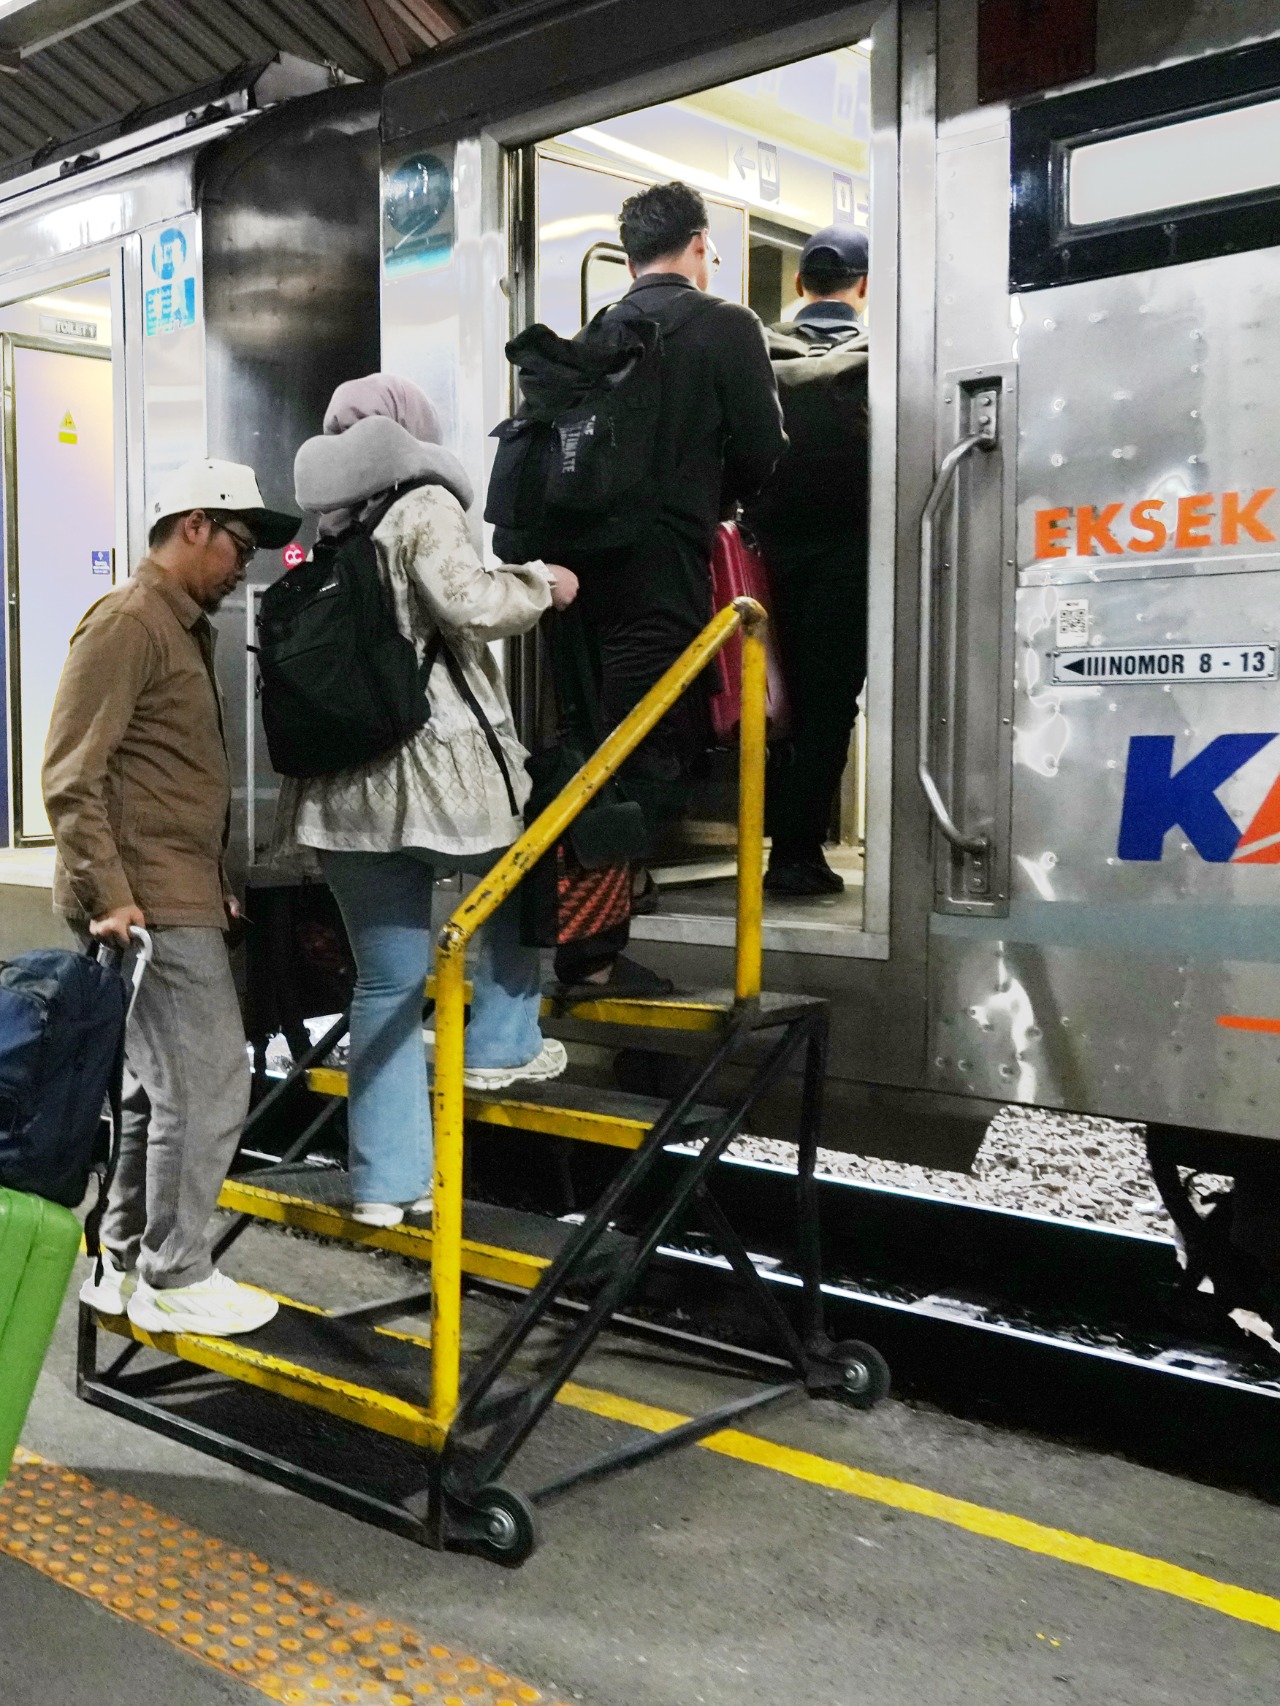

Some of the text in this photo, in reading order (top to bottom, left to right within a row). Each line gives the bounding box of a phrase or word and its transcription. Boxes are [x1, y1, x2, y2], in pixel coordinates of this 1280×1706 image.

[1035, 487, 1278, 560] EKSEK
[285, 549, 303, 564] QC
[1110, 654, 1184, 676] NOMOR
[1199, 653, 1212, 674] 8
[1241, 651, 1265, 672] 13
